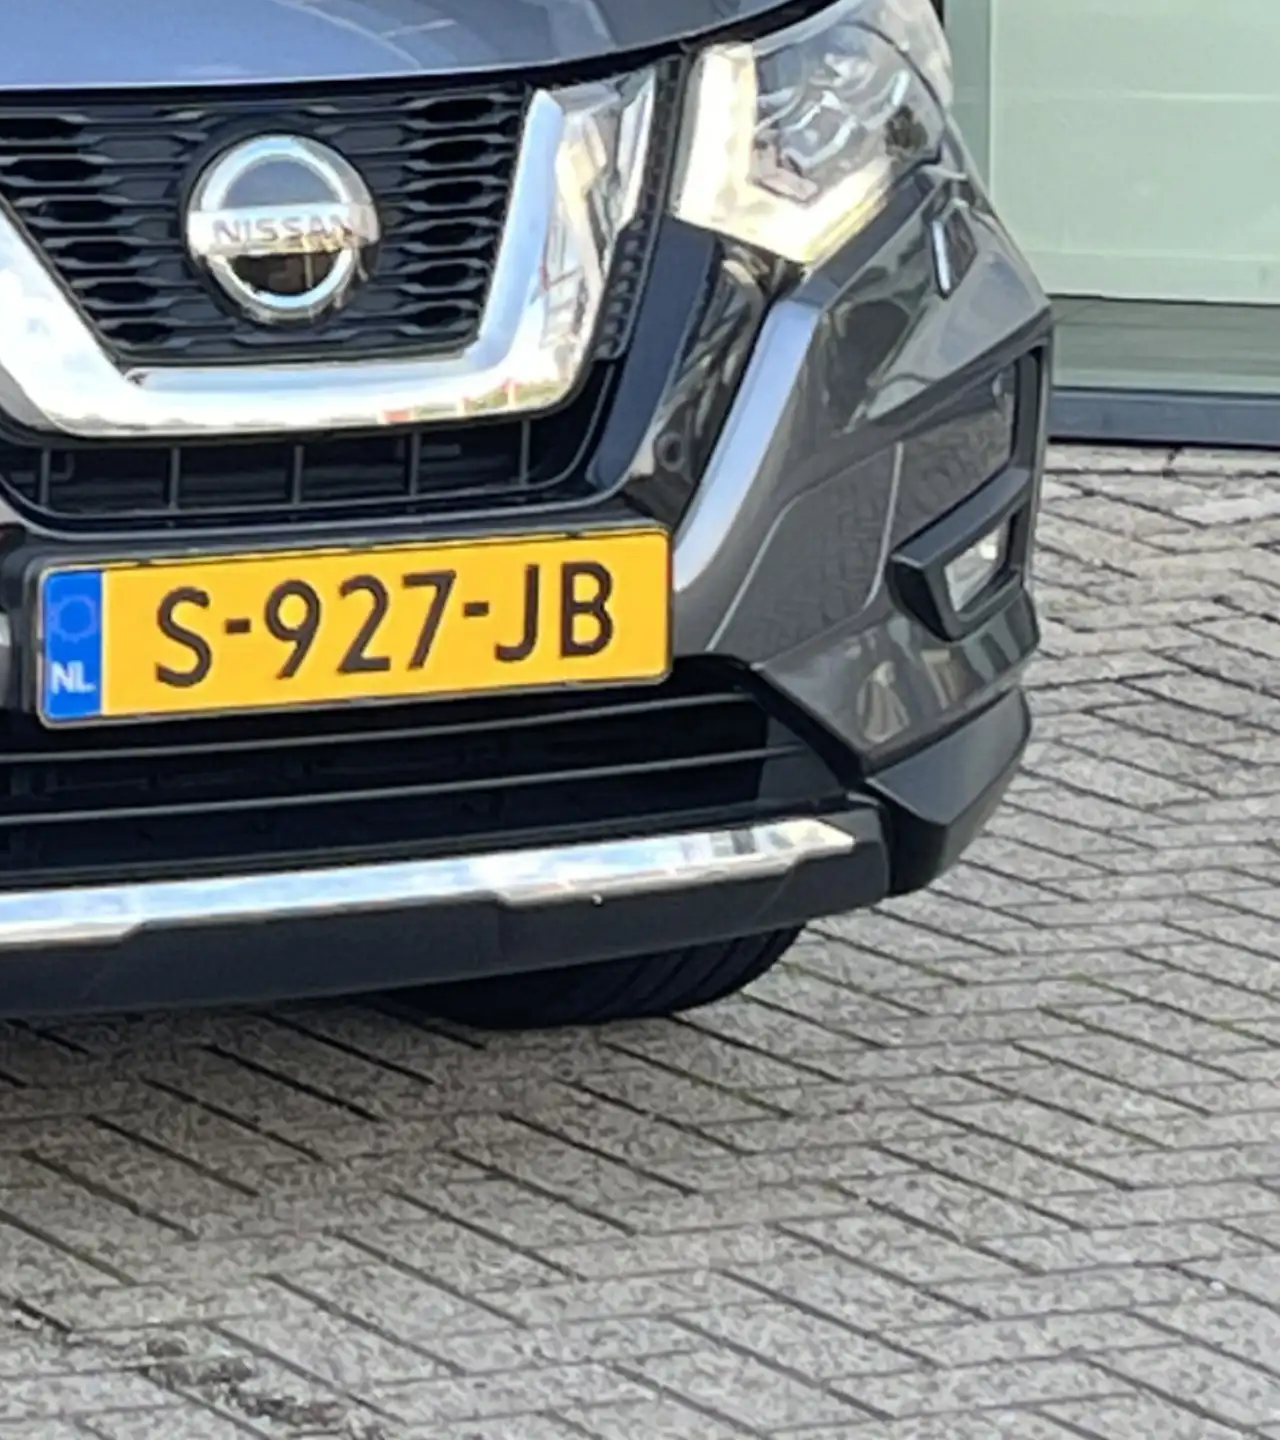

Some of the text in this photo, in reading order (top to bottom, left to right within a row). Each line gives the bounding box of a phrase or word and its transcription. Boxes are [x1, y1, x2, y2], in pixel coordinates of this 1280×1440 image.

[211, 213, 354, 245] NISSAN
[154, 561, 614, 687] S-927-JB
[49, 659, 97, 695] NL
